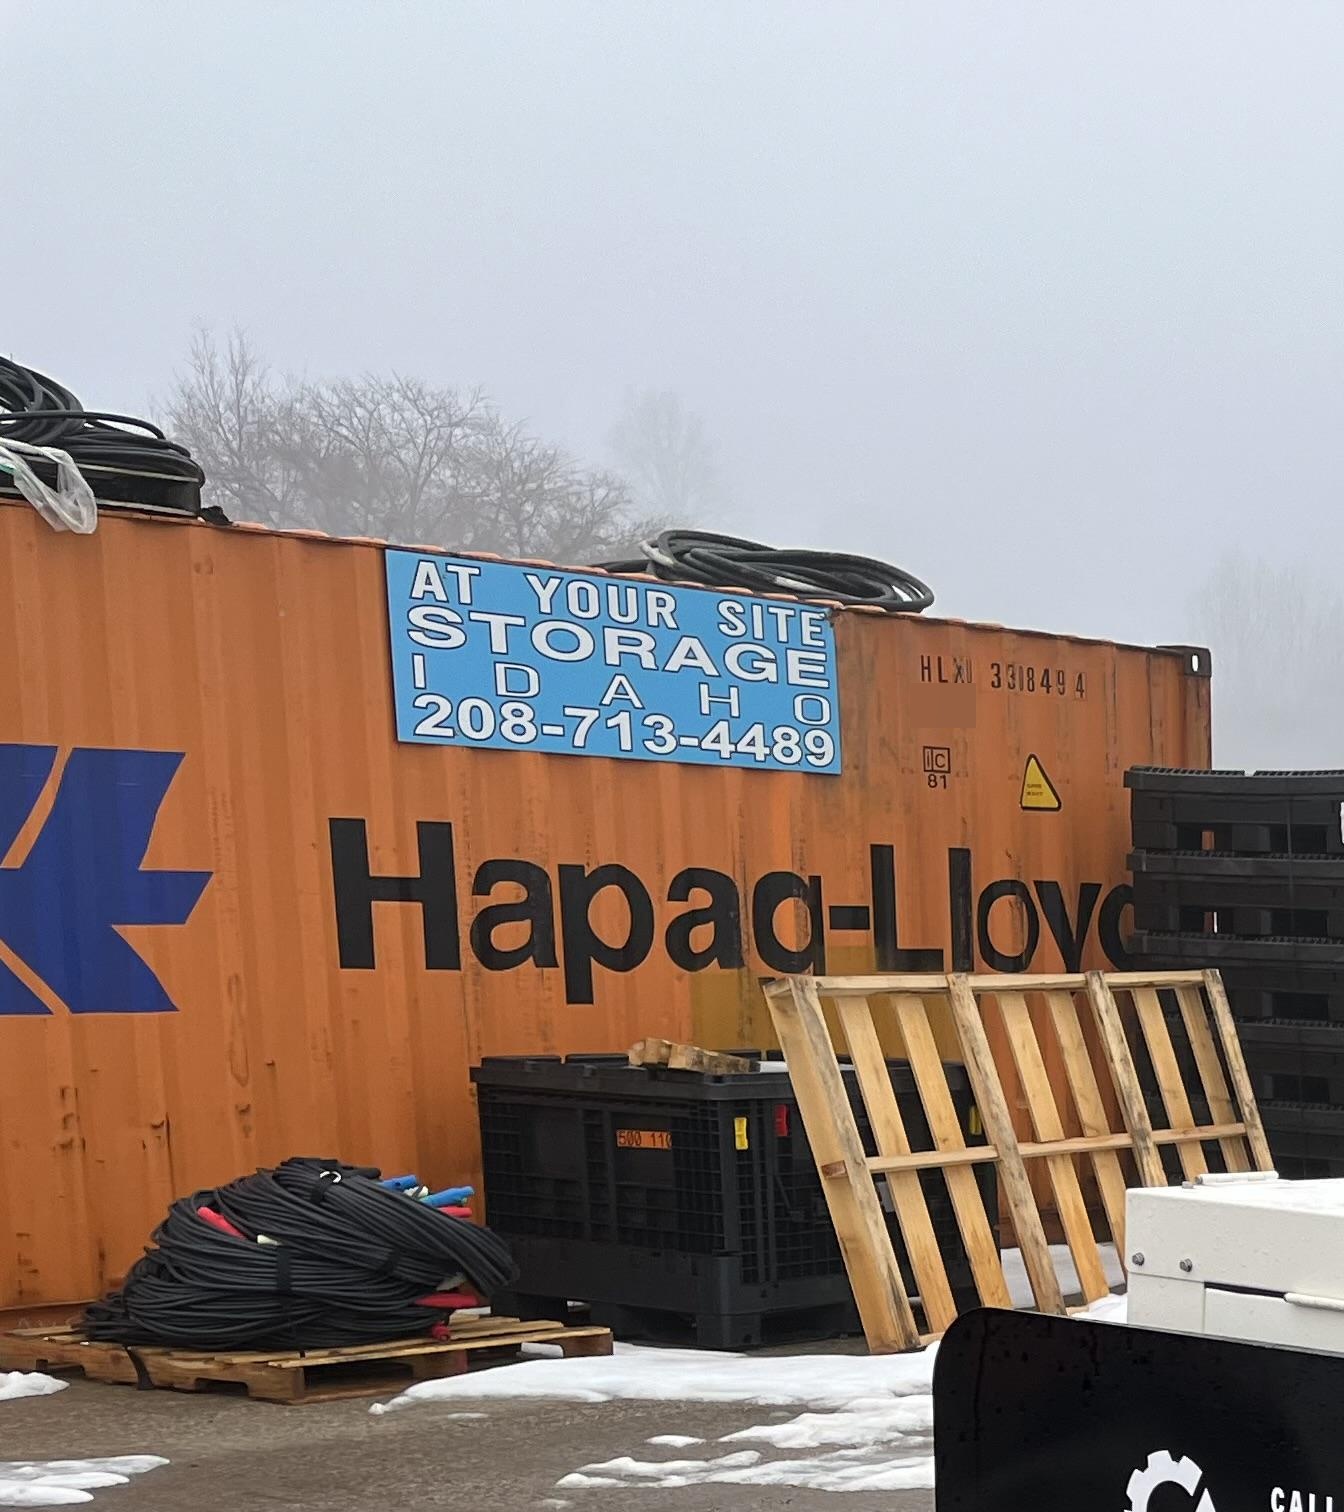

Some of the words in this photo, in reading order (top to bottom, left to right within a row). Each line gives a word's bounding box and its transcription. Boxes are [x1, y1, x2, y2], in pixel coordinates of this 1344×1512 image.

[410, 560, 480, 605] AT
[524, 573, 678, 630] YOUR
[718, 600, 826, 647] SITE
[407, 604, 829, 688] STORAGE
[921, 655, 972, 683] HLXU
[413, 694, 834, 767] 208-713-4489
[928, 773, 947, 789] 81
